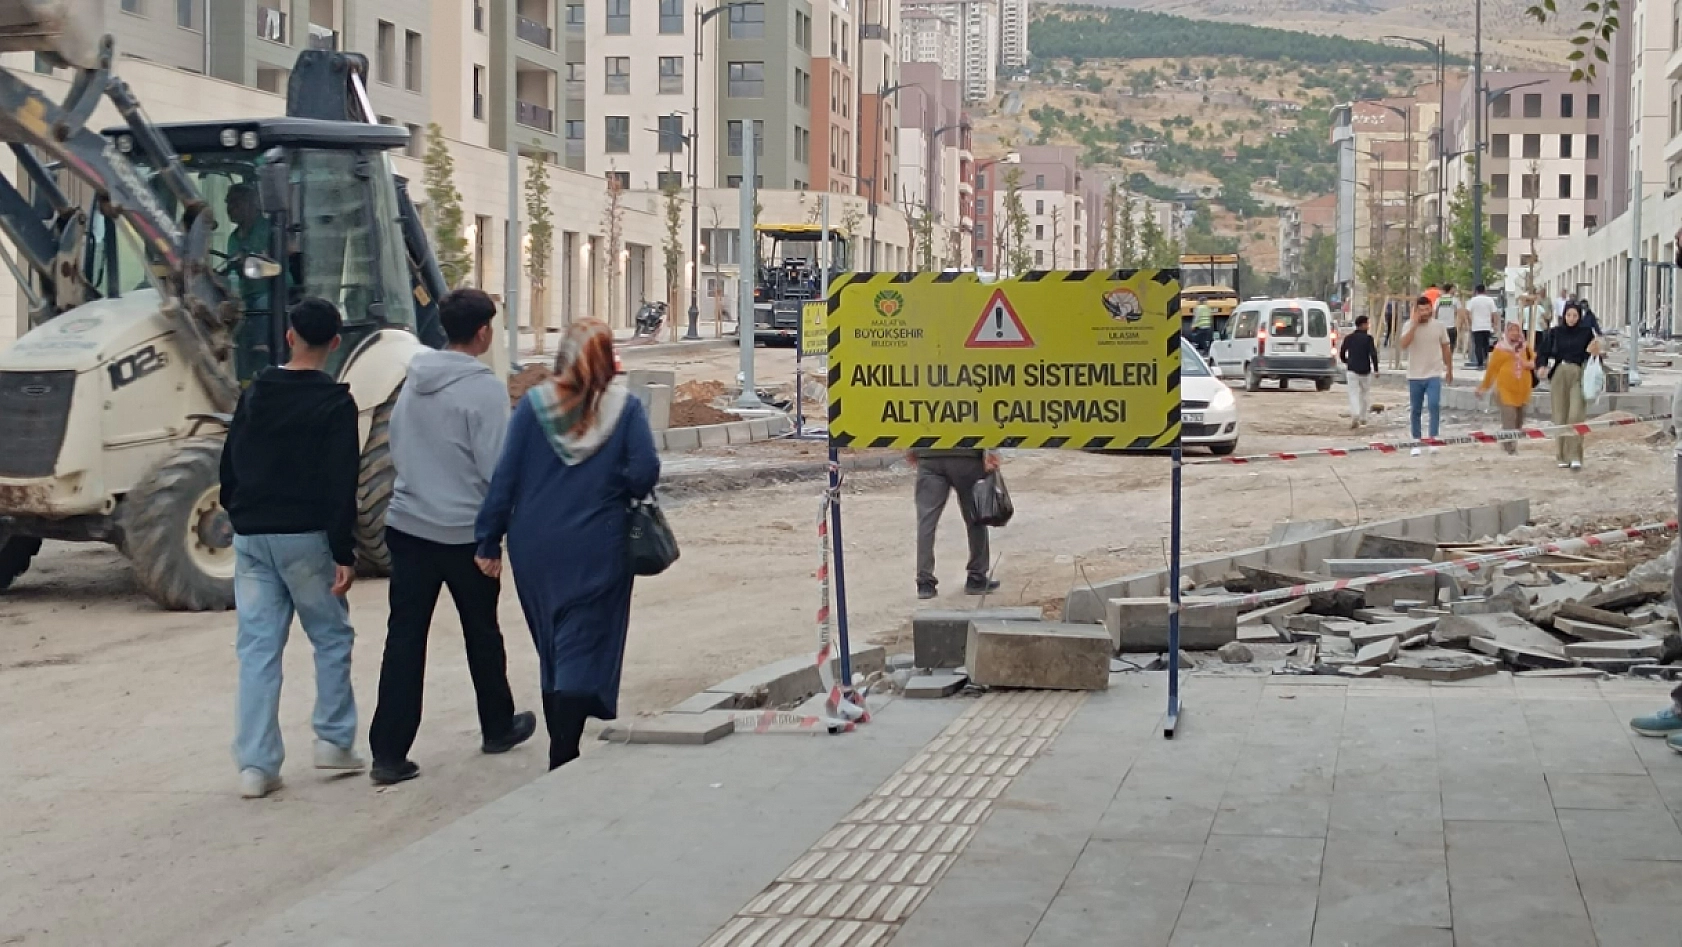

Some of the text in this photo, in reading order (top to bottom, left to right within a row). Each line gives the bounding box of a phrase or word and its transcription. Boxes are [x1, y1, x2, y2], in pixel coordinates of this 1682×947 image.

[851, 359, 1158, 393] AKILLI ULAŞIM SİSTEMLERİ
[881, 399, 1127, 429] ALTYAPI ÇALIŞMASI
